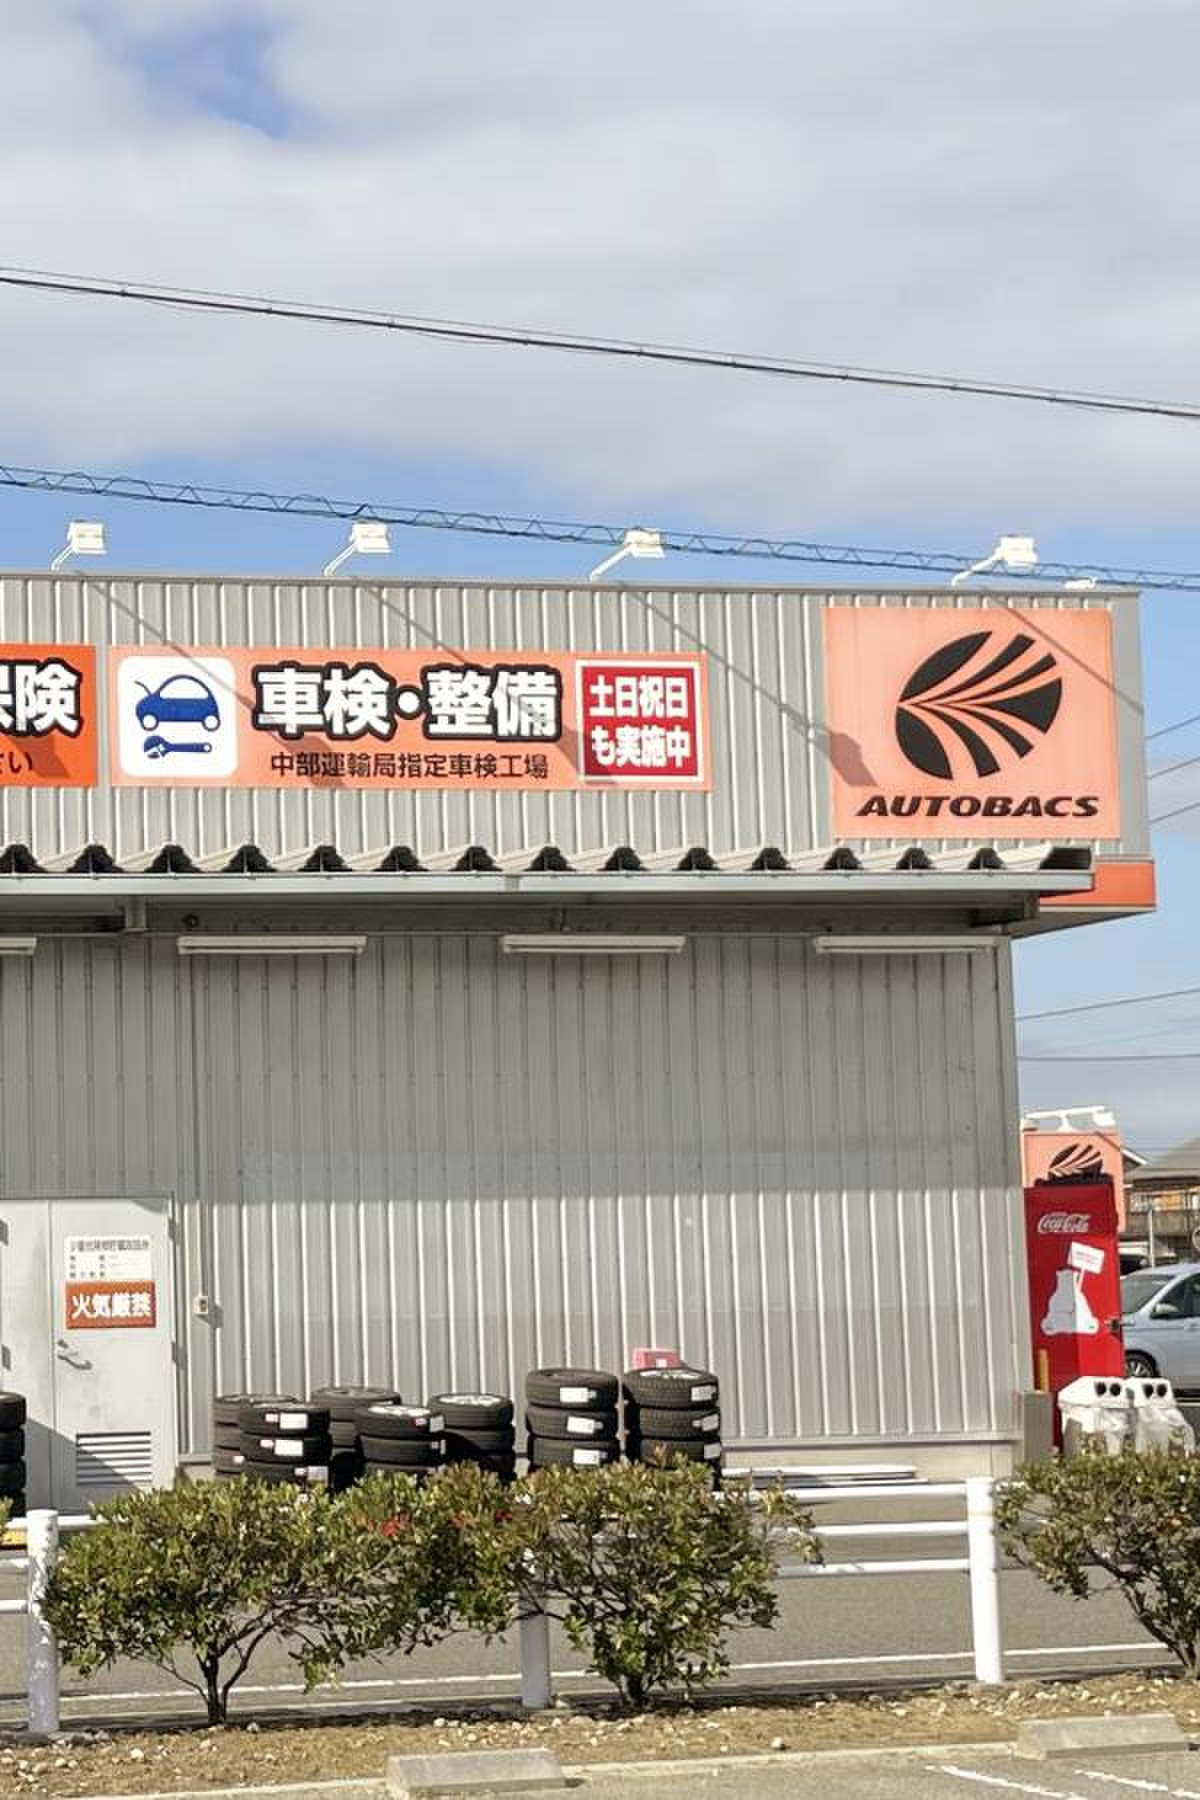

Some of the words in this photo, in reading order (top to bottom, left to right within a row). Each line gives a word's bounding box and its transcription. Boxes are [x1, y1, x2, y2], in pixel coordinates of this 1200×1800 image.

[253, 661, 562, 742] 車検・整備
[589, 675, 689, 718] 土日祝日
[591, 725, 691, 766] も実施中
[271, 753, 548, 780] 中部運輸局指定車検工場
[856, 795, 1099, 817] AUTOBACS
